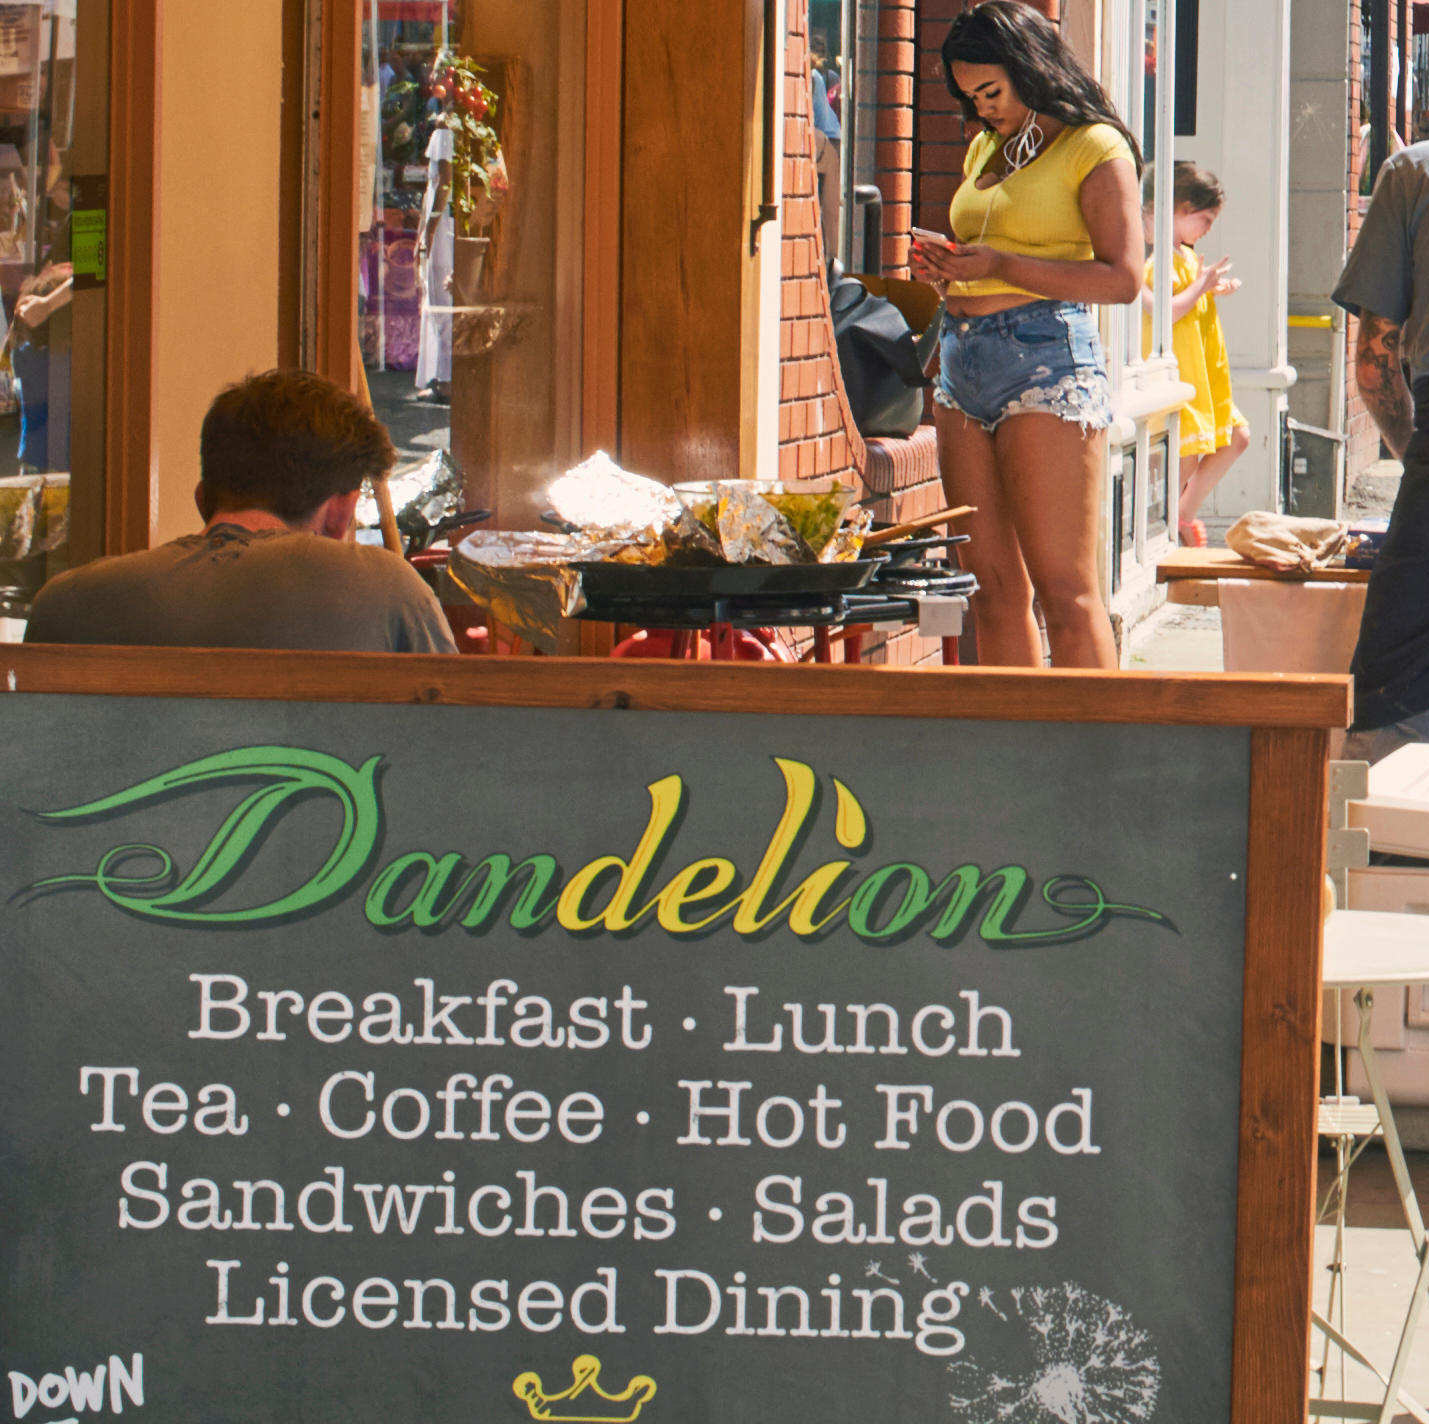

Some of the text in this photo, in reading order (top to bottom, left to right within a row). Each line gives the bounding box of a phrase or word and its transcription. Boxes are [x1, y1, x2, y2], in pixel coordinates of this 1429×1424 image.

[20, 744, 1180, 946] Dandelion
[188, 974, 1021, 1058] Breakfast Lunch
[80, 1066, 1101, 1156] Tea Coffee Hot Food
[118, 1161, 1059, 1257] Sandwiches Salads
[205, 1259, 969, 1356] Licensed Dining
[8, 1352, 144, 1418] DOWN
